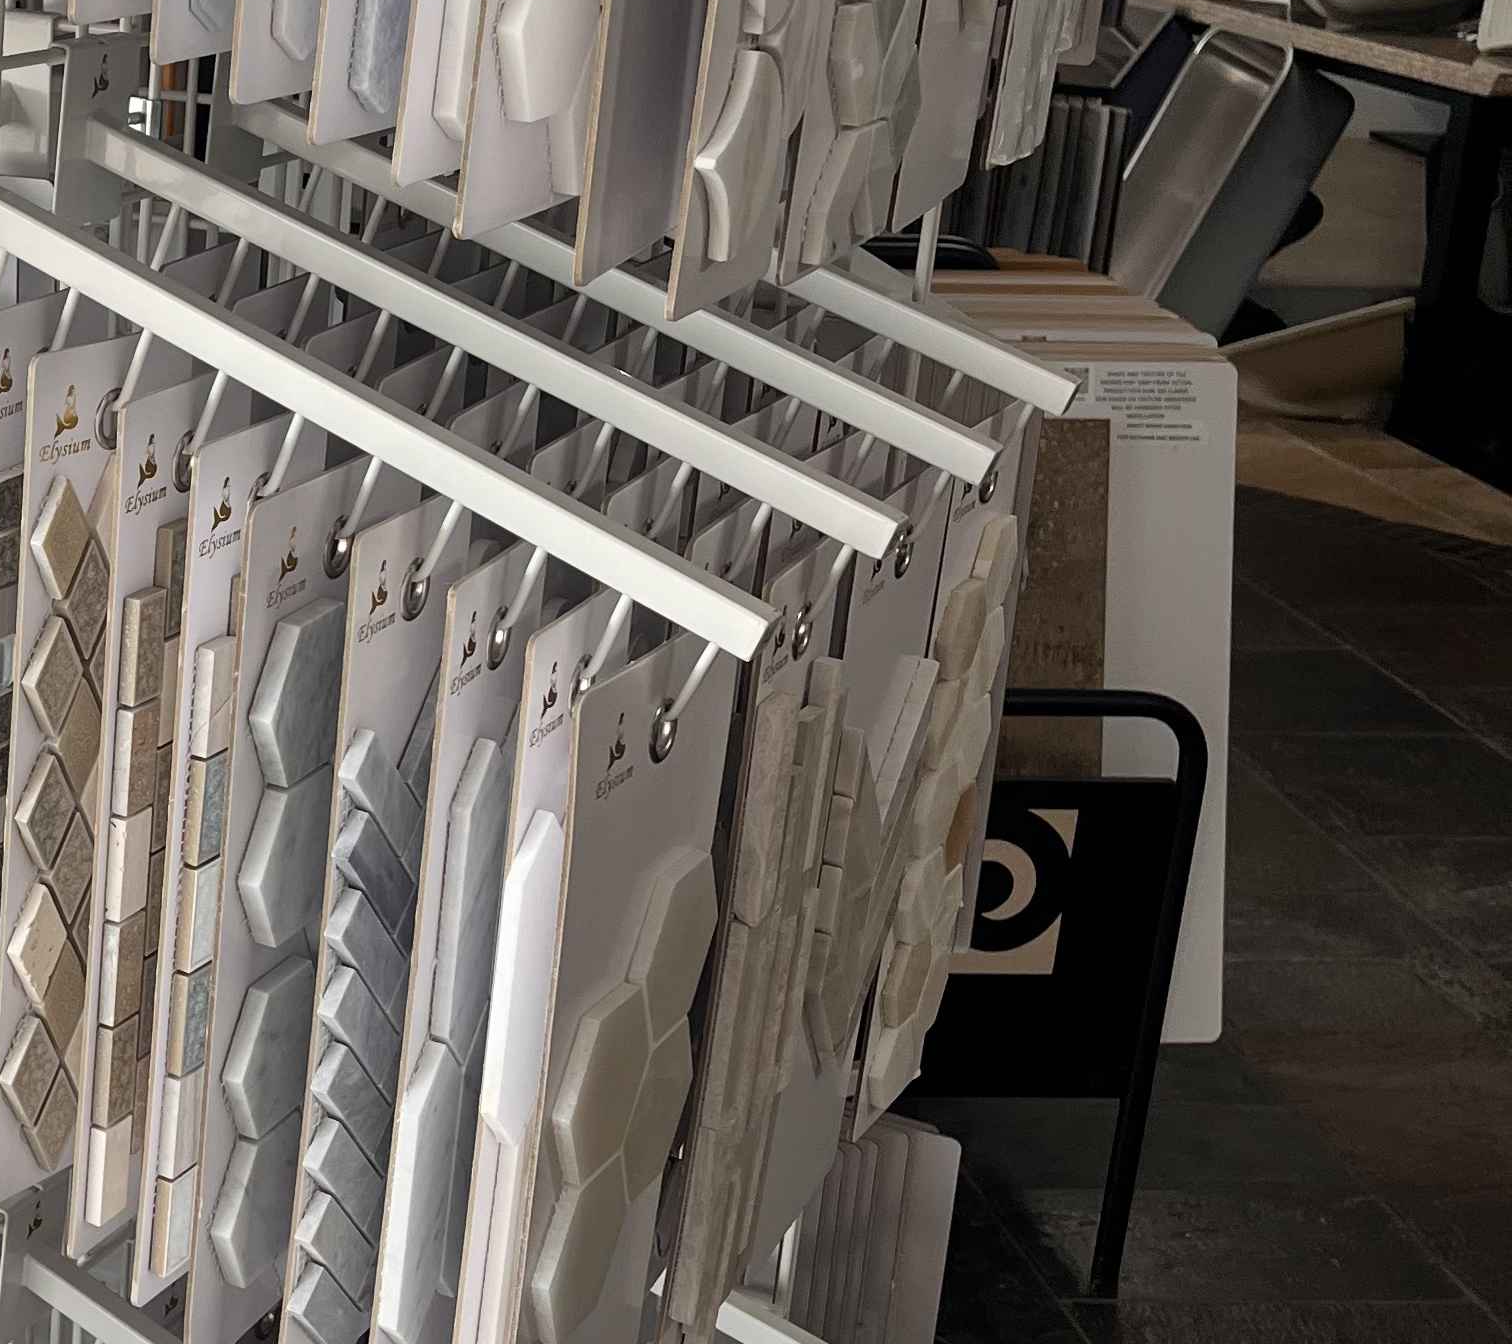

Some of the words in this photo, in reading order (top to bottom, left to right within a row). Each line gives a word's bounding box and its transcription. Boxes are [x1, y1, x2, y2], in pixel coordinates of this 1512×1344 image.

[40, 438, 92, 464] Elysium
[125, 486, 167, 514] Elysium
[198, 529, 241, 559] Elysium
[358, 612, 396, 643] Elysium
